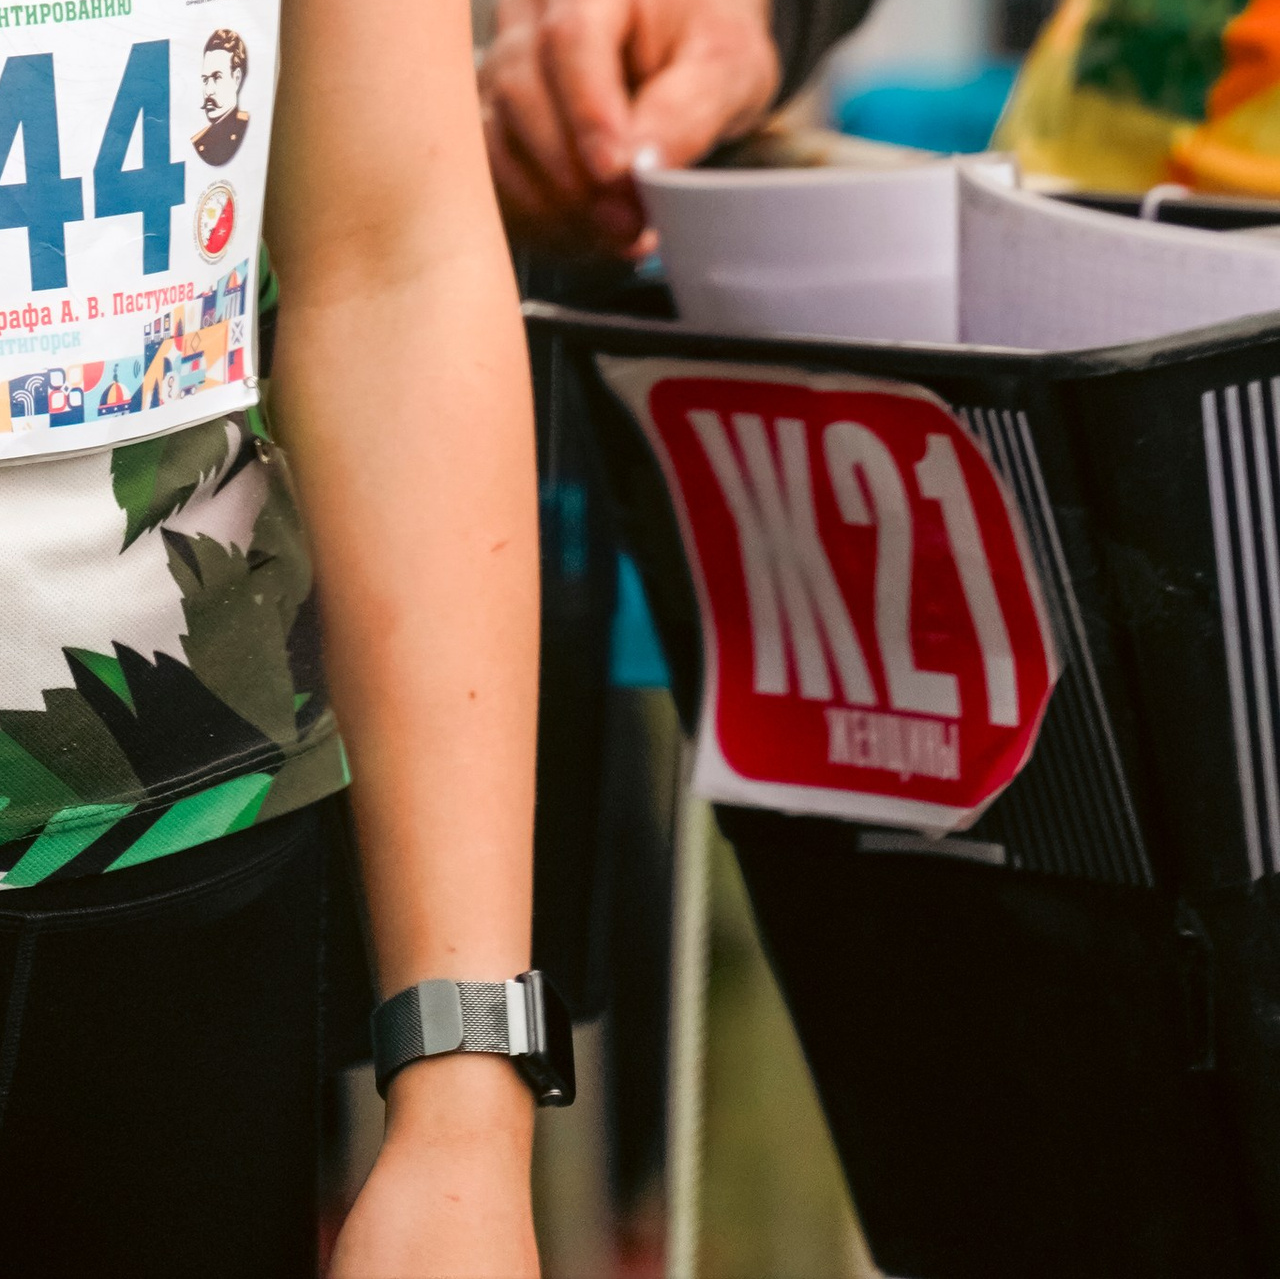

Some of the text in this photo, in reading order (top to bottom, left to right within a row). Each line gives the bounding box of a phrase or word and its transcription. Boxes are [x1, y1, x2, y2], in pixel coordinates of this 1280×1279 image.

[61, 299, 80, 323] А.
[87, 296, 105, 320] В.
[112, 281, 195, 314] Пастухова
[686, 408, 1020, 728] Ж21
